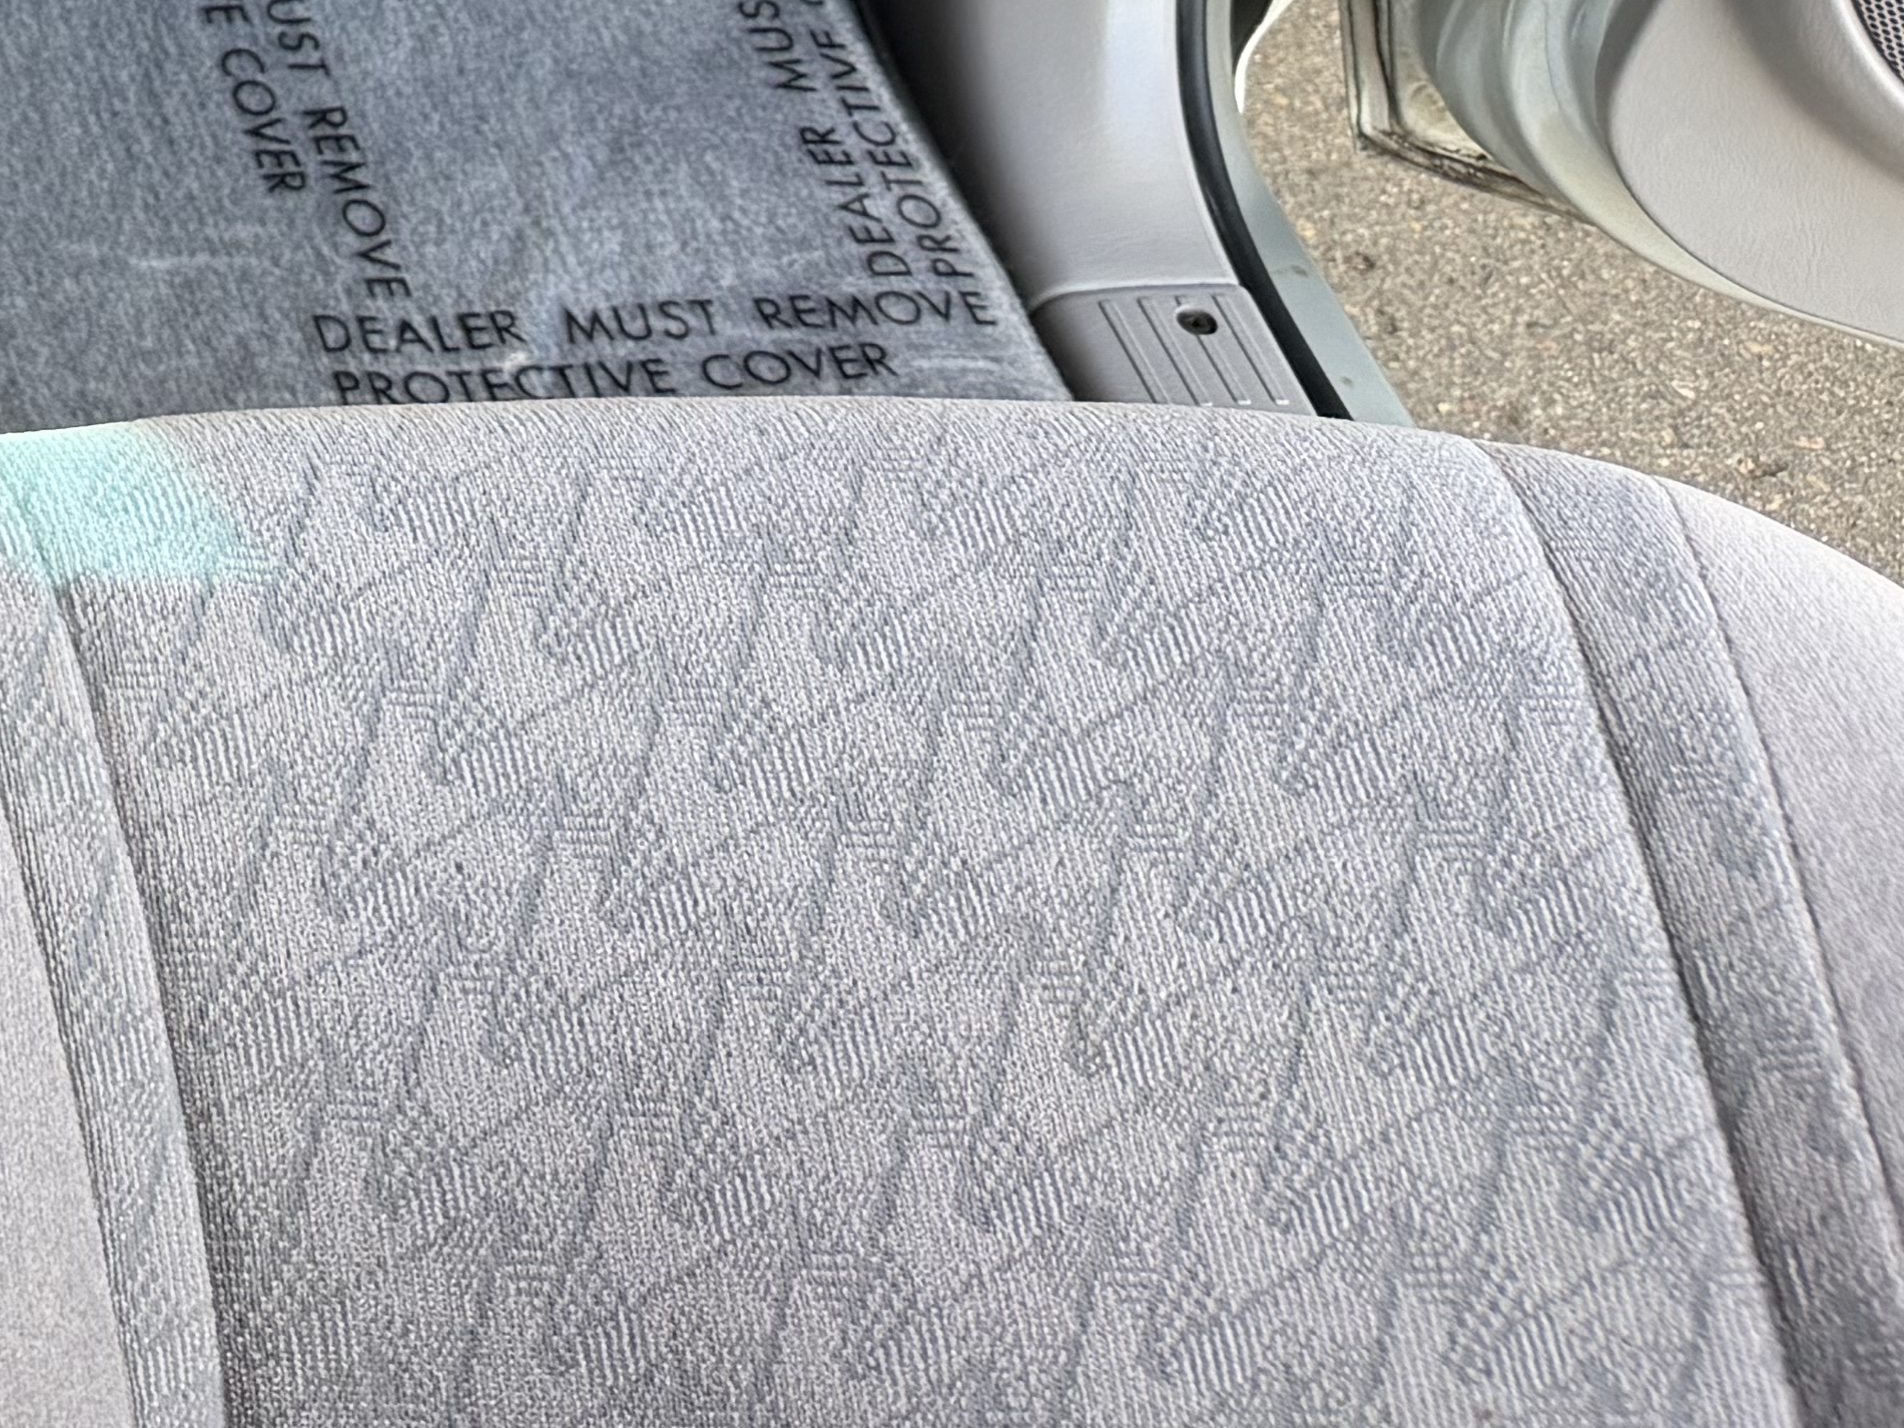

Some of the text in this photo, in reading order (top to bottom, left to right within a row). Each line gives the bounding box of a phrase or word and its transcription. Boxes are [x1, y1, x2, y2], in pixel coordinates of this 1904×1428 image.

[220, 47, 308, 196] COVER
[303, 105, 413, 301] REMOVE
[800, 123, 914, 279] DEALER
[313, 288, 1000, 355] DEALER MUST REMOVE
[334, 343, 900, 406] PROTECTIVE COVER
